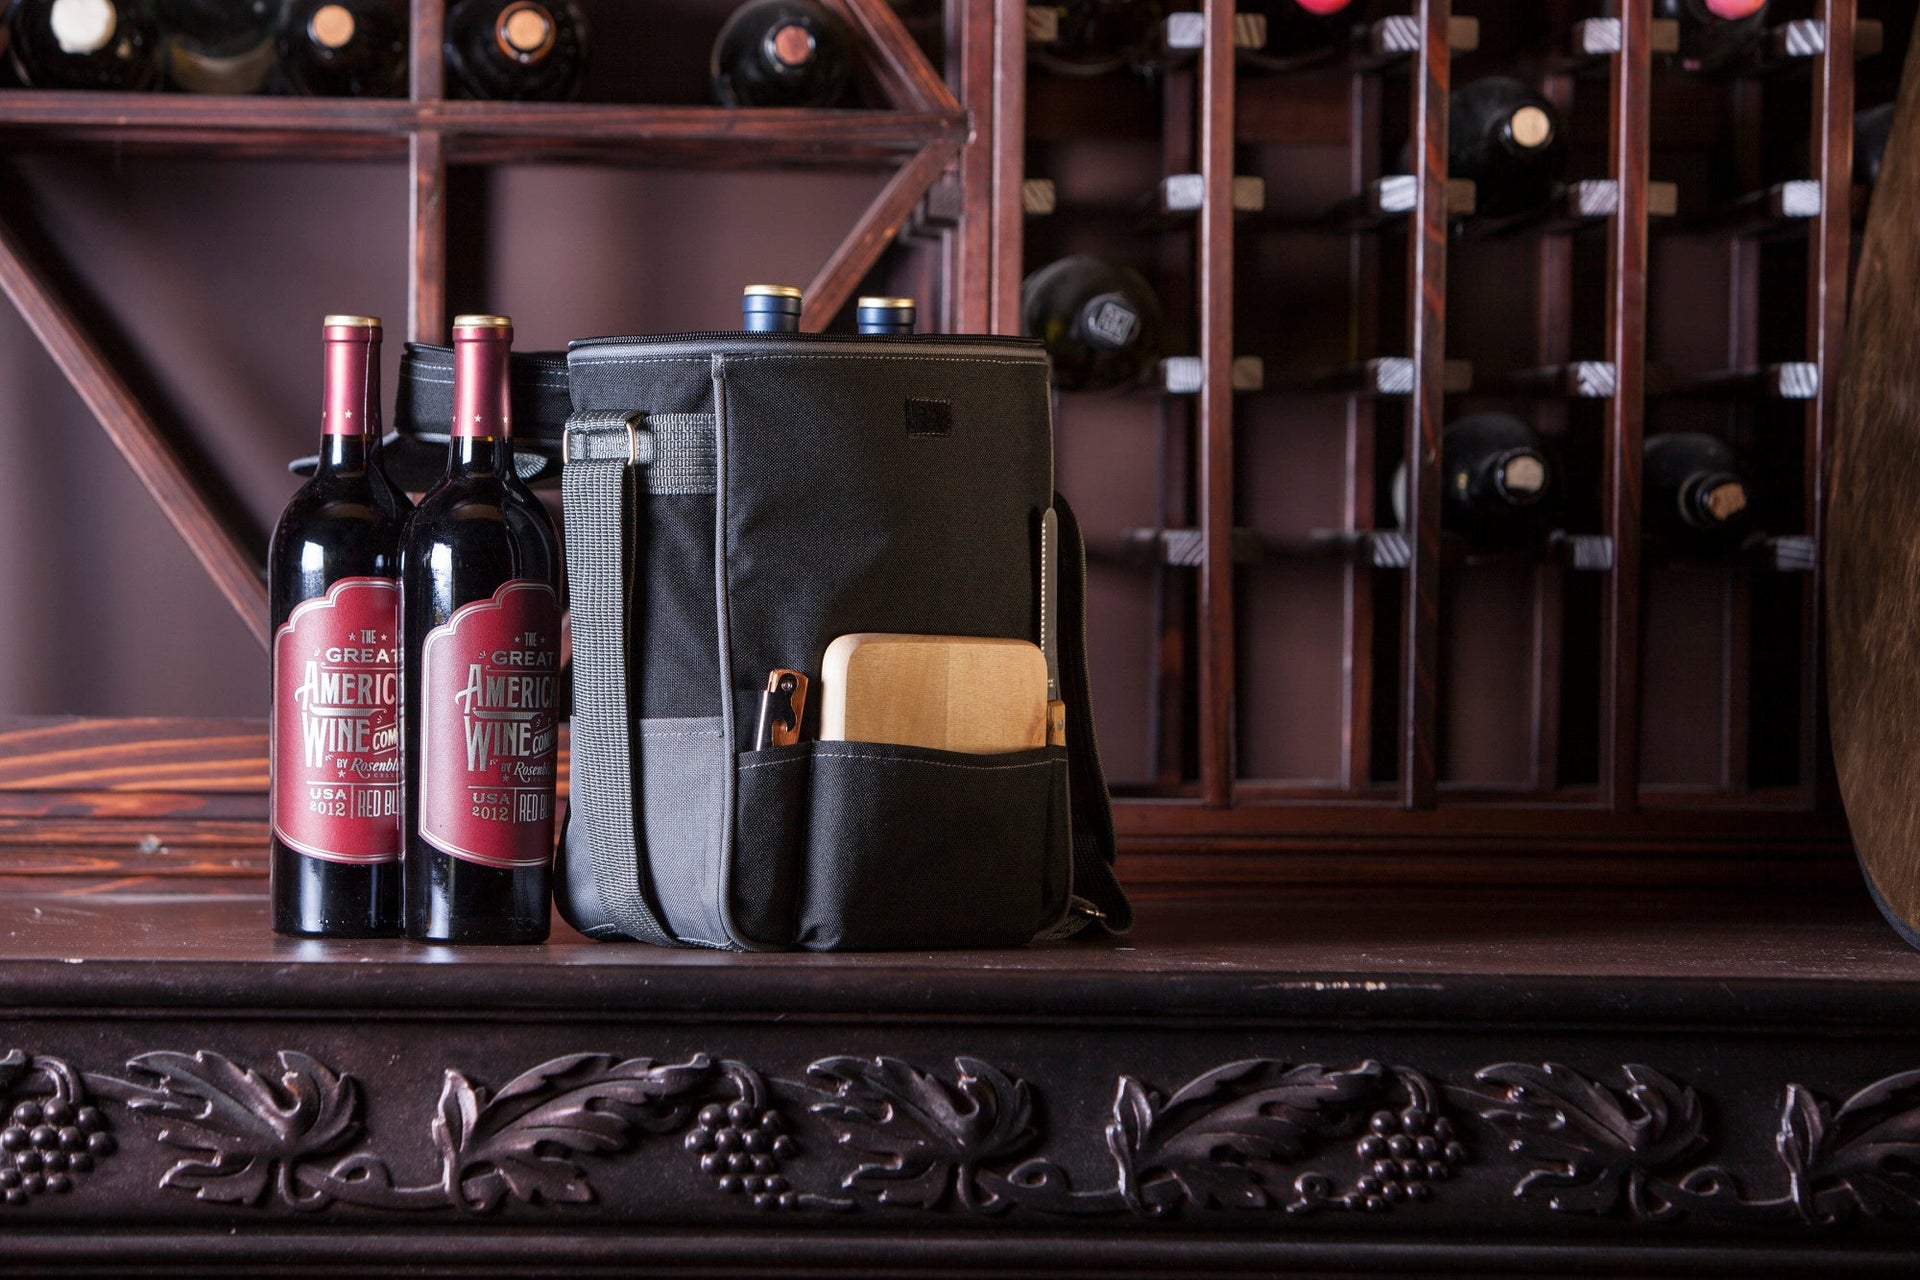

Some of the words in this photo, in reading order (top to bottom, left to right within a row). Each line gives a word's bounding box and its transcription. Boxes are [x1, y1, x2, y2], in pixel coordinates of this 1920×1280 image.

[360, 629, 377, 645] THE
[524, 631, 537, 647] THE
[491, 650, 556, 667] GREAT
[301, 711, 371, 768] WINE
[463, 716, 532, 772] WINE
[336, 758, 349, 769] BY
[501, 762, 512, 773] BY
[309, 787, 348, 801] USA
[472, 792, 511, 805] USA
[309, 801, 346, 816] 2012
[357, 789, 381, 818] RED
[519, 793, 539, 822] RED
[471, 806, 509, 821] 2012
